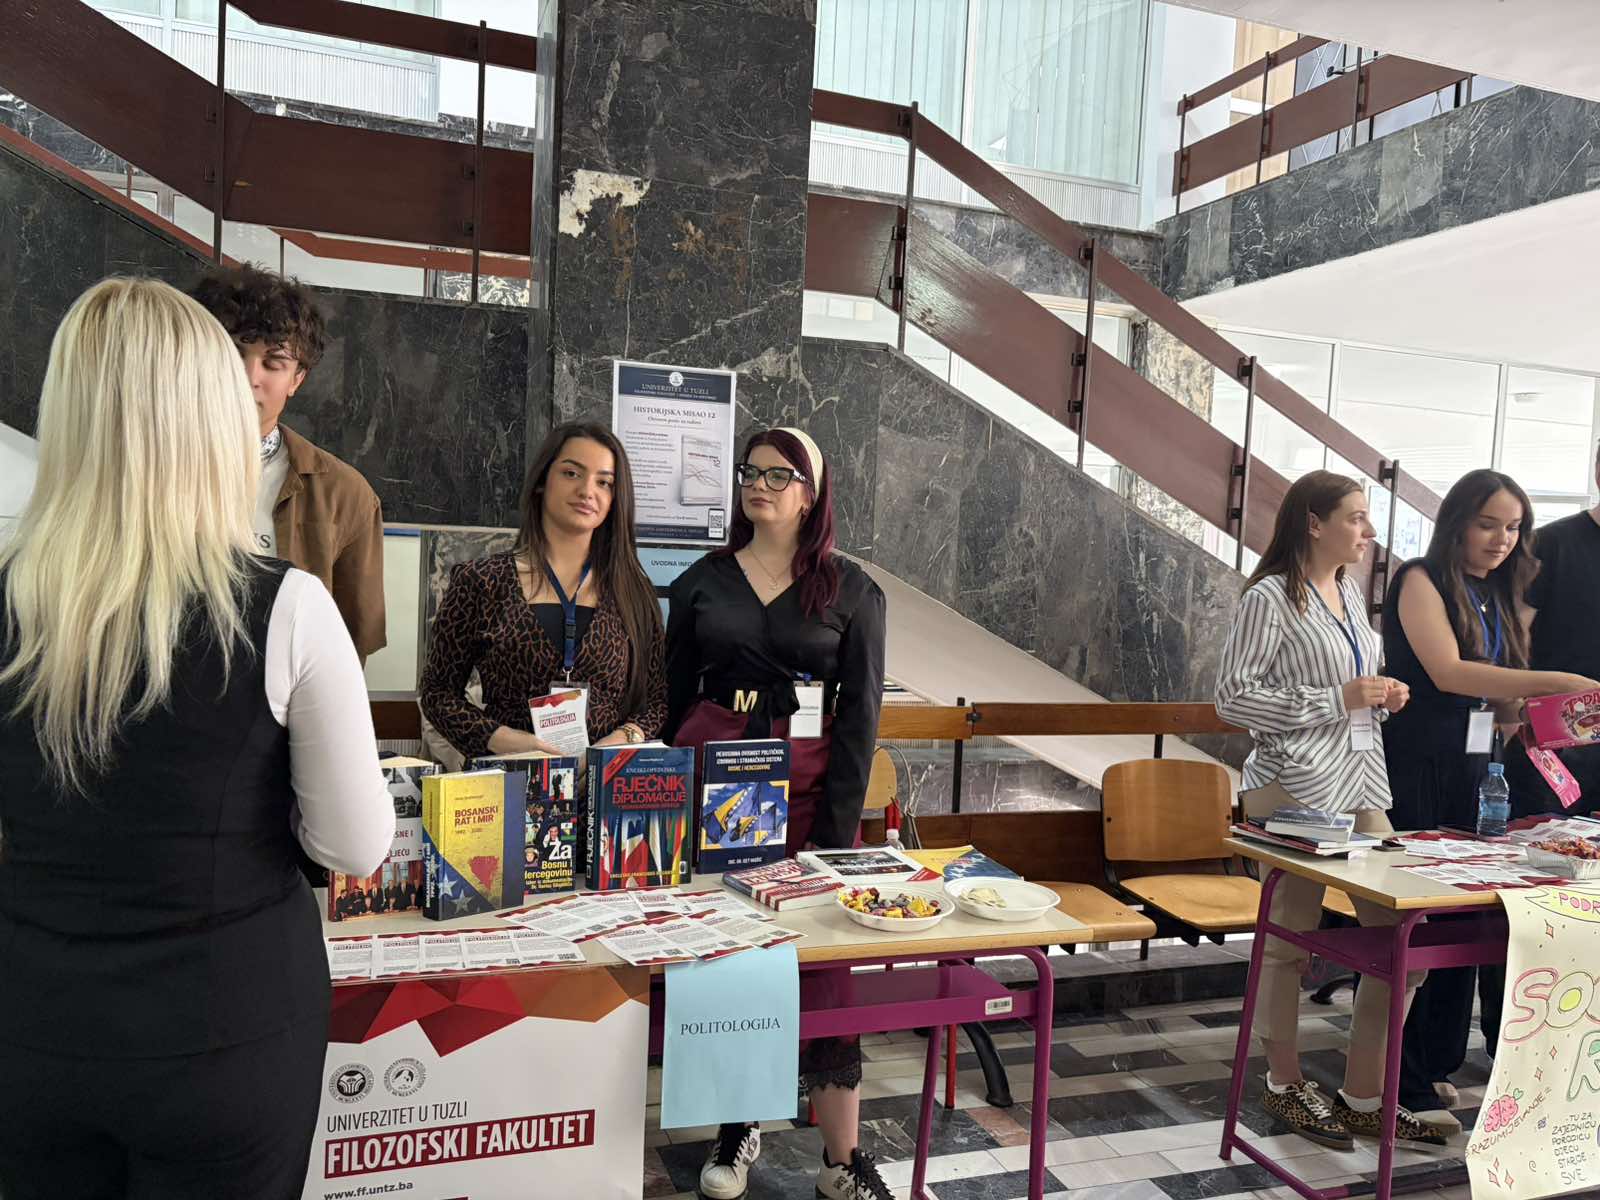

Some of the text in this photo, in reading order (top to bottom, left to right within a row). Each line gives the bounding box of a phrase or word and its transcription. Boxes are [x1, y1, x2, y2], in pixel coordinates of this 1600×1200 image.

[633, 405, 681, 417] HISTORIJSKA
[650, 559, 678, 567] UVODNA
[612, 773, 687, 794] RJEČNIK
[612, 790, 688, 805] DIPLOMACIJE
[454, 805, 499, 818] BOSANSKI
[454, 817, 471, 827] RAT
[477, 813, 495, 823] MIR
[548, 840, 573, 861] Za
[541, 860, 568, 870] Bosnu
[680, 1017, 781, 1036] POLITOLOGIJA
[327, 1100, 468, 1133] UNIVERZITET U TUZLI
[1582, 1112, 1593, 1121] ZA
[1551, 1120, 1597, 1136] ZAJEDNICU
[327, 1113, 590, 1175] FILOZOFSKI FAKULTET
[1551, 1132, 1591, 1146] PORODICU
[1560, 1168, 1588, 1185] SVE
[323, 1182, 414, 1200] www.ff.untz.ba
